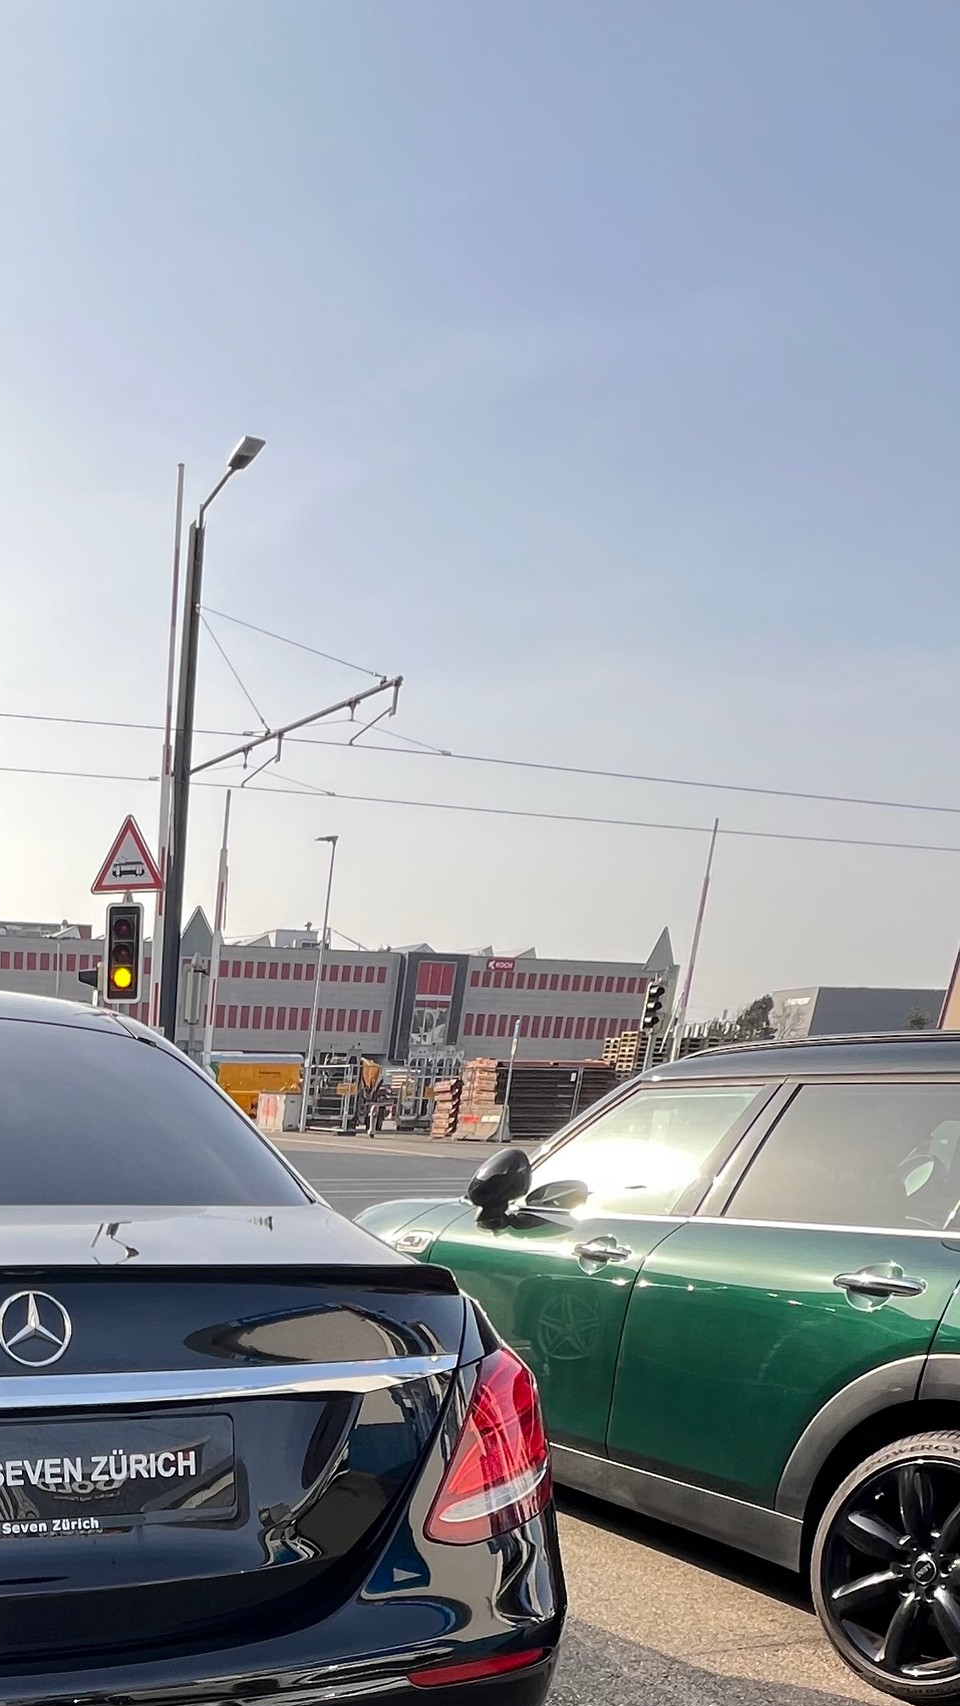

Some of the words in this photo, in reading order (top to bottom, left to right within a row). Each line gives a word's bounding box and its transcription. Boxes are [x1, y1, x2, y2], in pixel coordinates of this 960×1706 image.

[90, 1449, 196, 1481] ZÜRICH
[2, 1522, 47, 1535] Seven
[52, 1517, 99, 1532] Zürich
